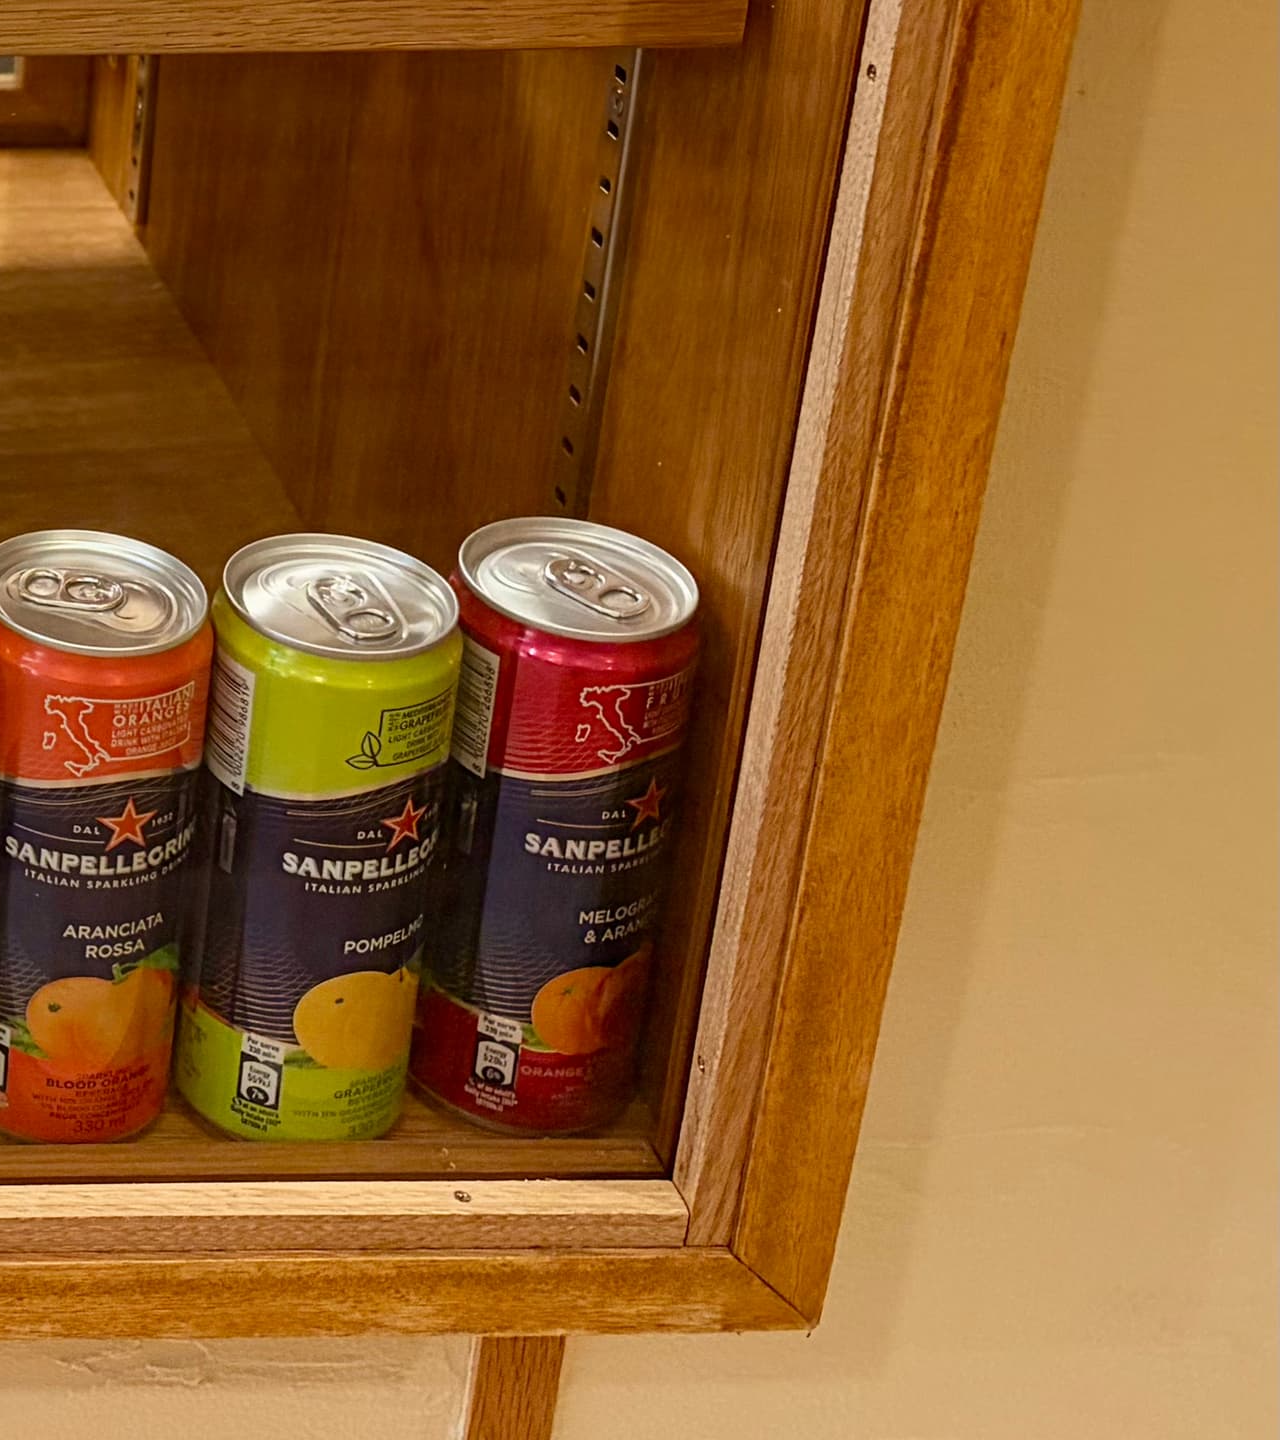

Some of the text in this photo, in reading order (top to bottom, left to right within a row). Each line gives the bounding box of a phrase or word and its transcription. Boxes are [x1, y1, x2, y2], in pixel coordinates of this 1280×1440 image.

[112, 701, 190, 728] ORANGES
[72, 824, 101, 835] DAL
[357, 829, 383, 840] DAL
[547, 863, 605, 874] ITALIAN
[25, 868, 157, 889] ITALIAN SPARKLING
[304, 882, 362, 894] ITALIAN
[63, 911, 163, 939] ARANCIATA
[584, 929, 597, 944] &
[85, 938, 145, 959] ROSSA
[520, 1064, 584, 1078] ORANGE
